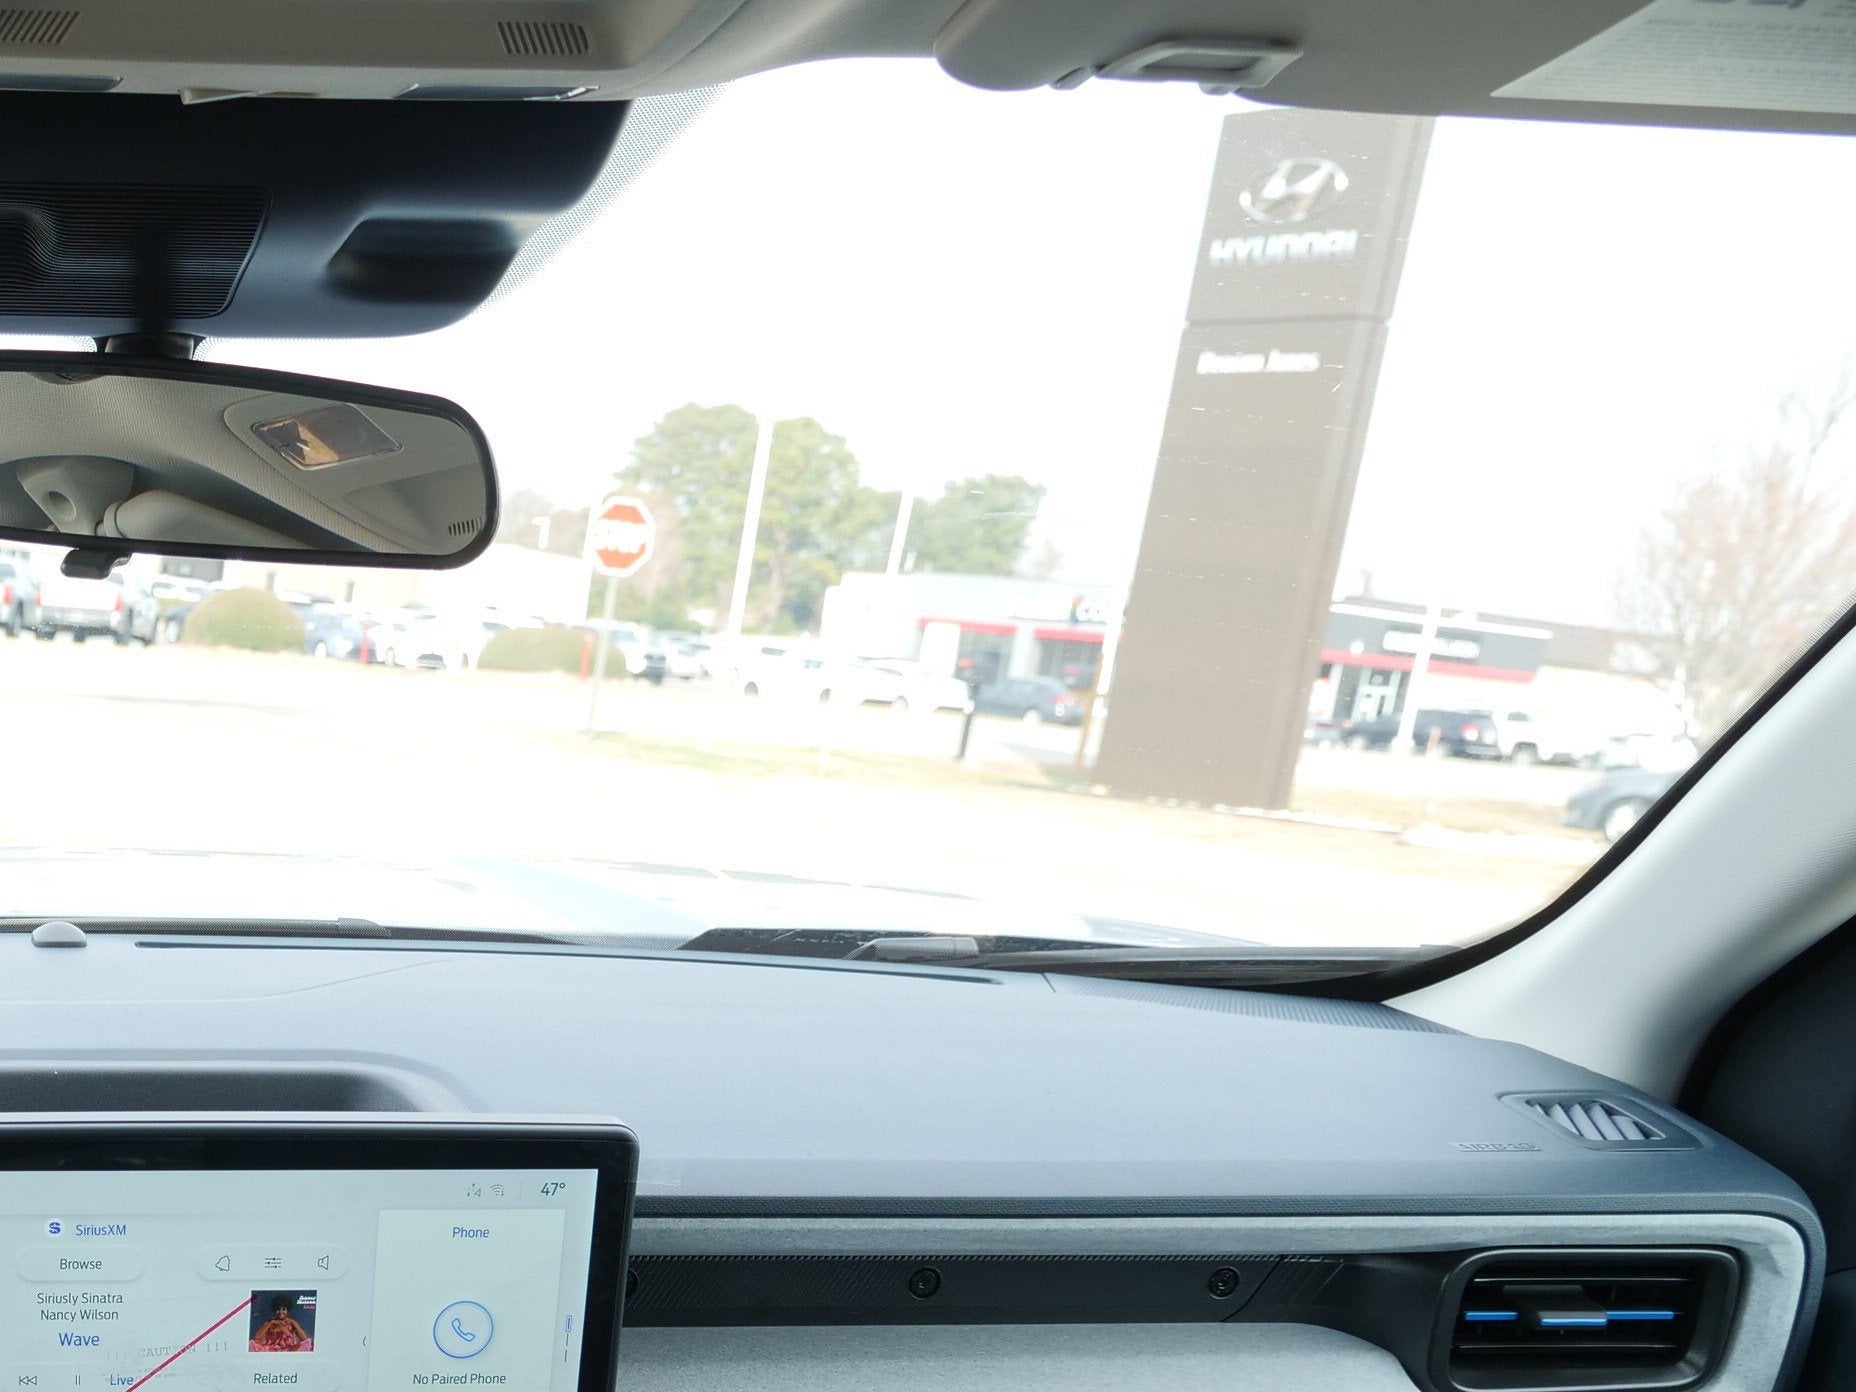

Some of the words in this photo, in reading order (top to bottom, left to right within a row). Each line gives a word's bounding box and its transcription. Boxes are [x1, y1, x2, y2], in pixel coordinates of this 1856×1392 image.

[541, 1182, 566, 1197] 47°
[75, 1224, 127, 1236] SiriusXM
[452, 1227, 490, 1238] Phone
[60, 1258, 102, 1270] Browse
[37, 1292, 78, 1306] Siriusly
[82, 1292, 123, 1304] Sinatra
[40, 1309, 77, 1322] Nancy
[79, 1309, 119, 1320] Wilson
[58, 1332, 100, 1347] Wave
[109, 1374, 134, 1386] Live
[253, 1373, 298, 1384] Related
[413, 1374, 428, 1385] No
[432, 1373, 467, 1385] Paired
[470, 1373, 507, 1384] Phone
